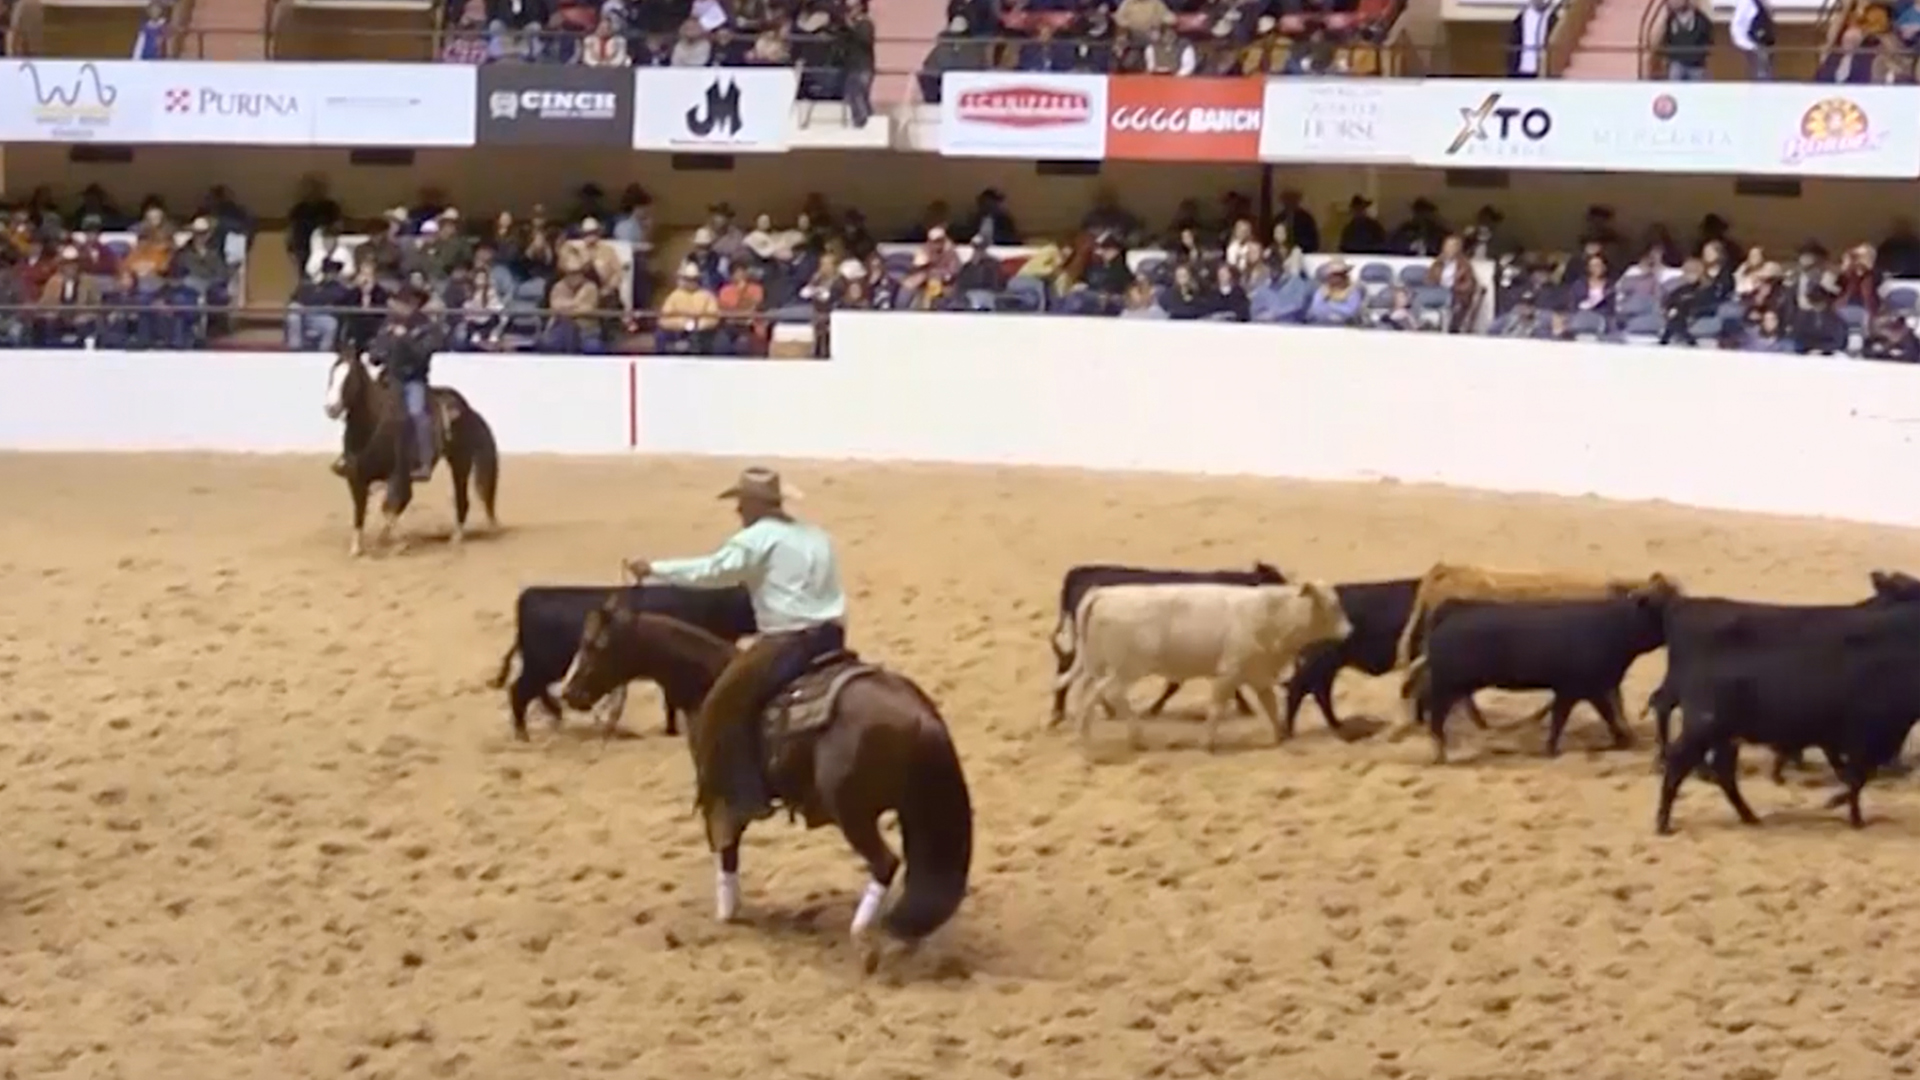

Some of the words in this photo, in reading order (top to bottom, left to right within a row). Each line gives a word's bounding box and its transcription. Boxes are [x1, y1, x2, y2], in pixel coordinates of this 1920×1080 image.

[199, 87, 298, 116] PURINA
[521, 90, 616, 110] CINCH
[1187, 107, 1260, 132] RANCH
[1444, 92, 1552, 154] XTO
